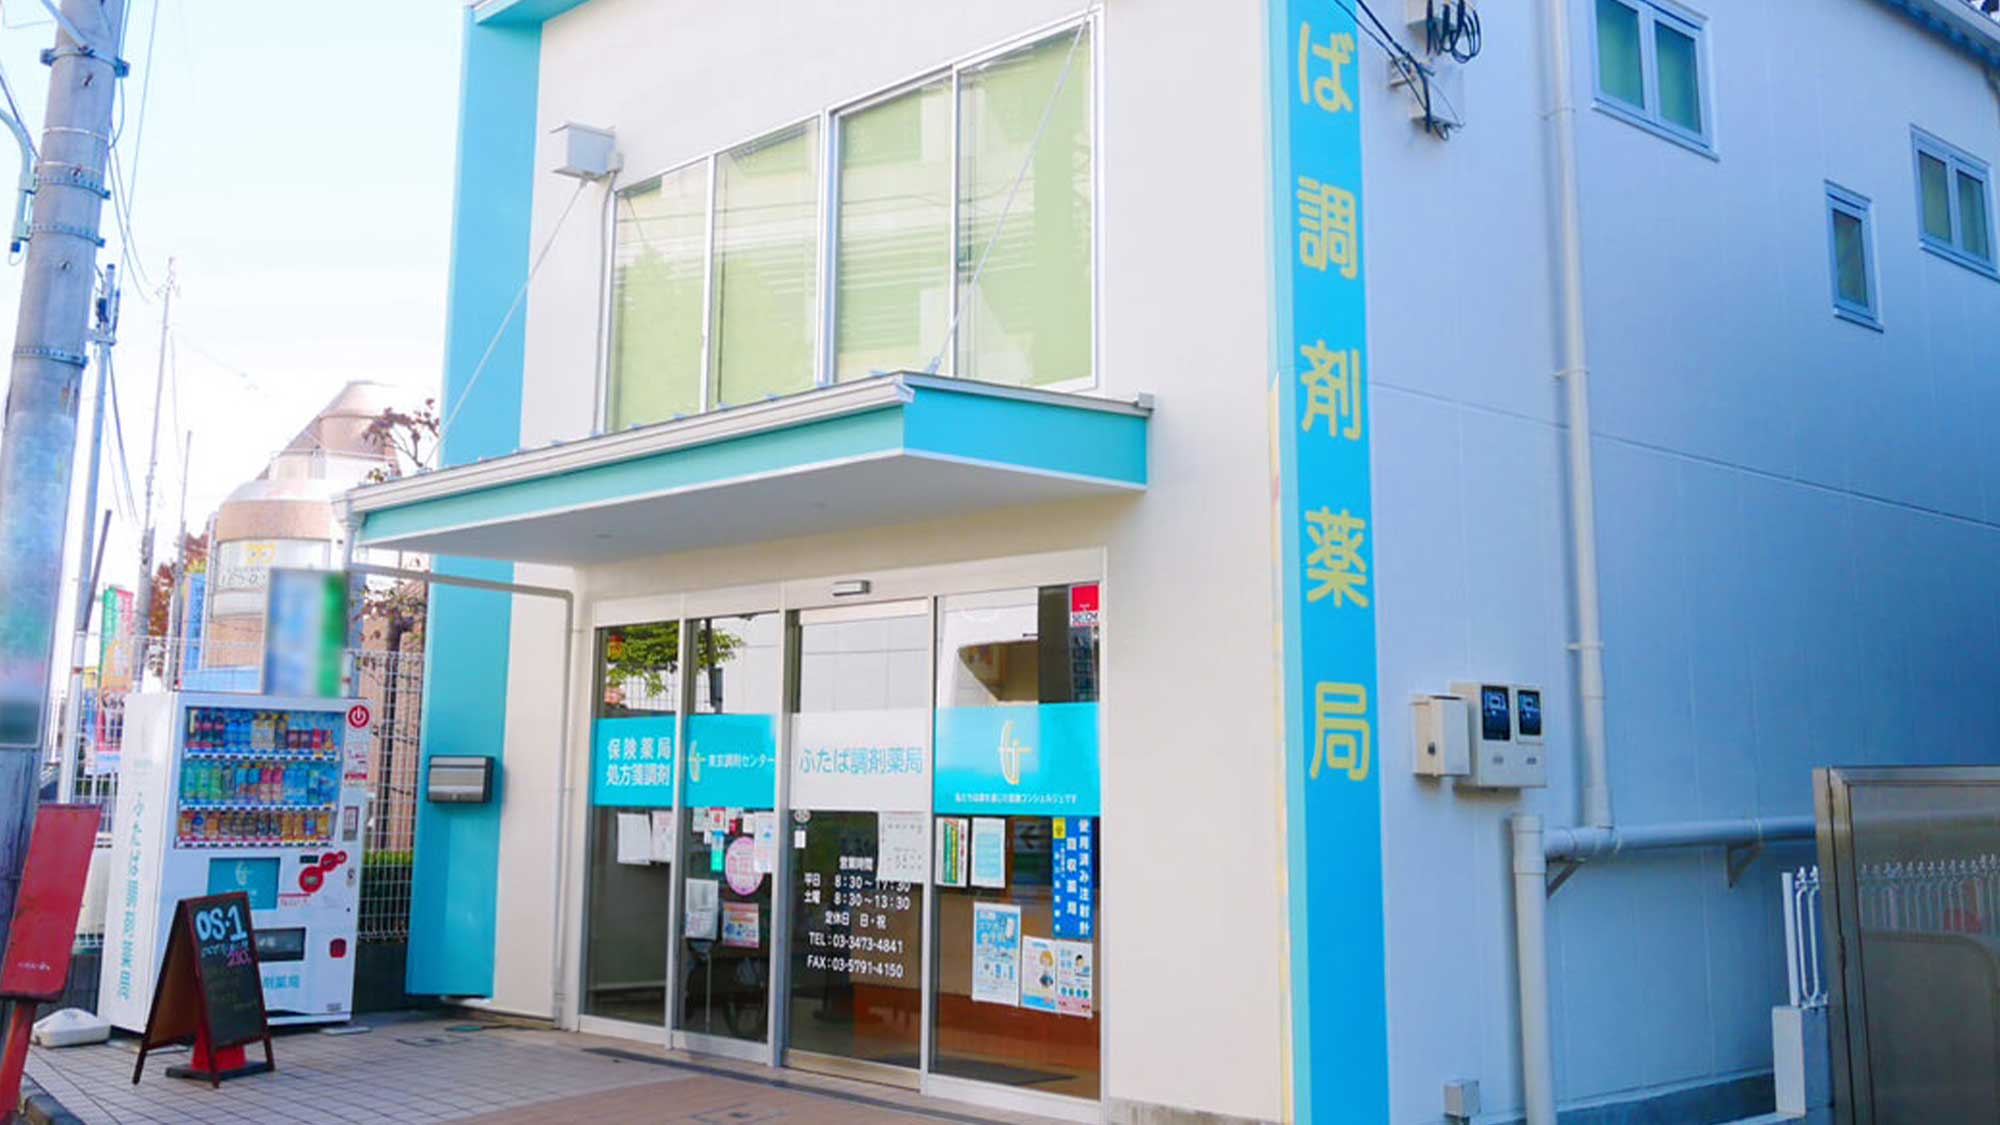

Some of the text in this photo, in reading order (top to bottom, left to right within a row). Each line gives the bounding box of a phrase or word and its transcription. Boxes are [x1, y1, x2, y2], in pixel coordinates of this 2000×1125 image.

[1297, 21, 1371, 782] ば調剤薬局
[607, 737, 672, 760] 保険薬局
[800, 746, 923, 774] ふたば調剤薬局
[803, 872, 821, 888] 平日
